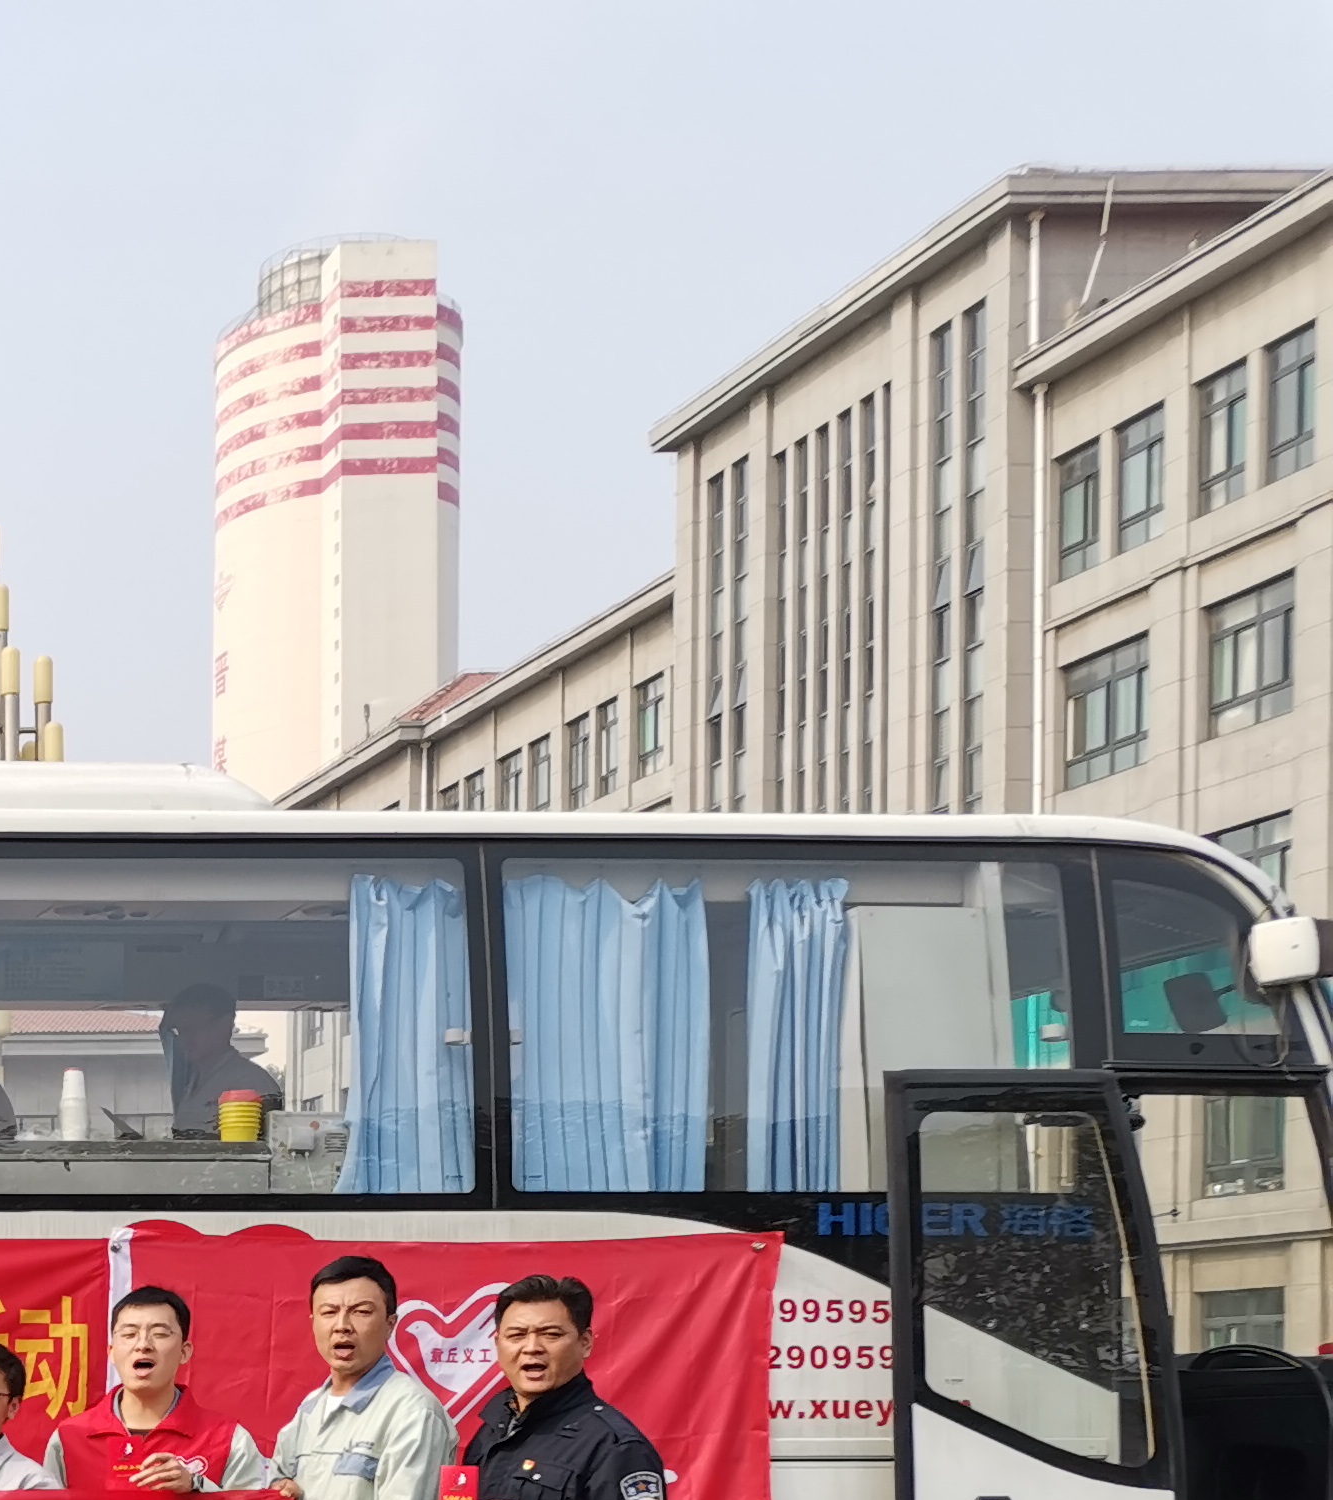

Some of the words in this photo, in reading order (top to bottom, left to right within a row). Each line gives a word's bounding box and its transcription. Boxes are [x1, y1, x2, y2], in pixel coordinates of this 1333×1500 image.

[1000, 1204, 1095, 1237] 海格
[430, 1347, 491, 1364] 章丘义工
